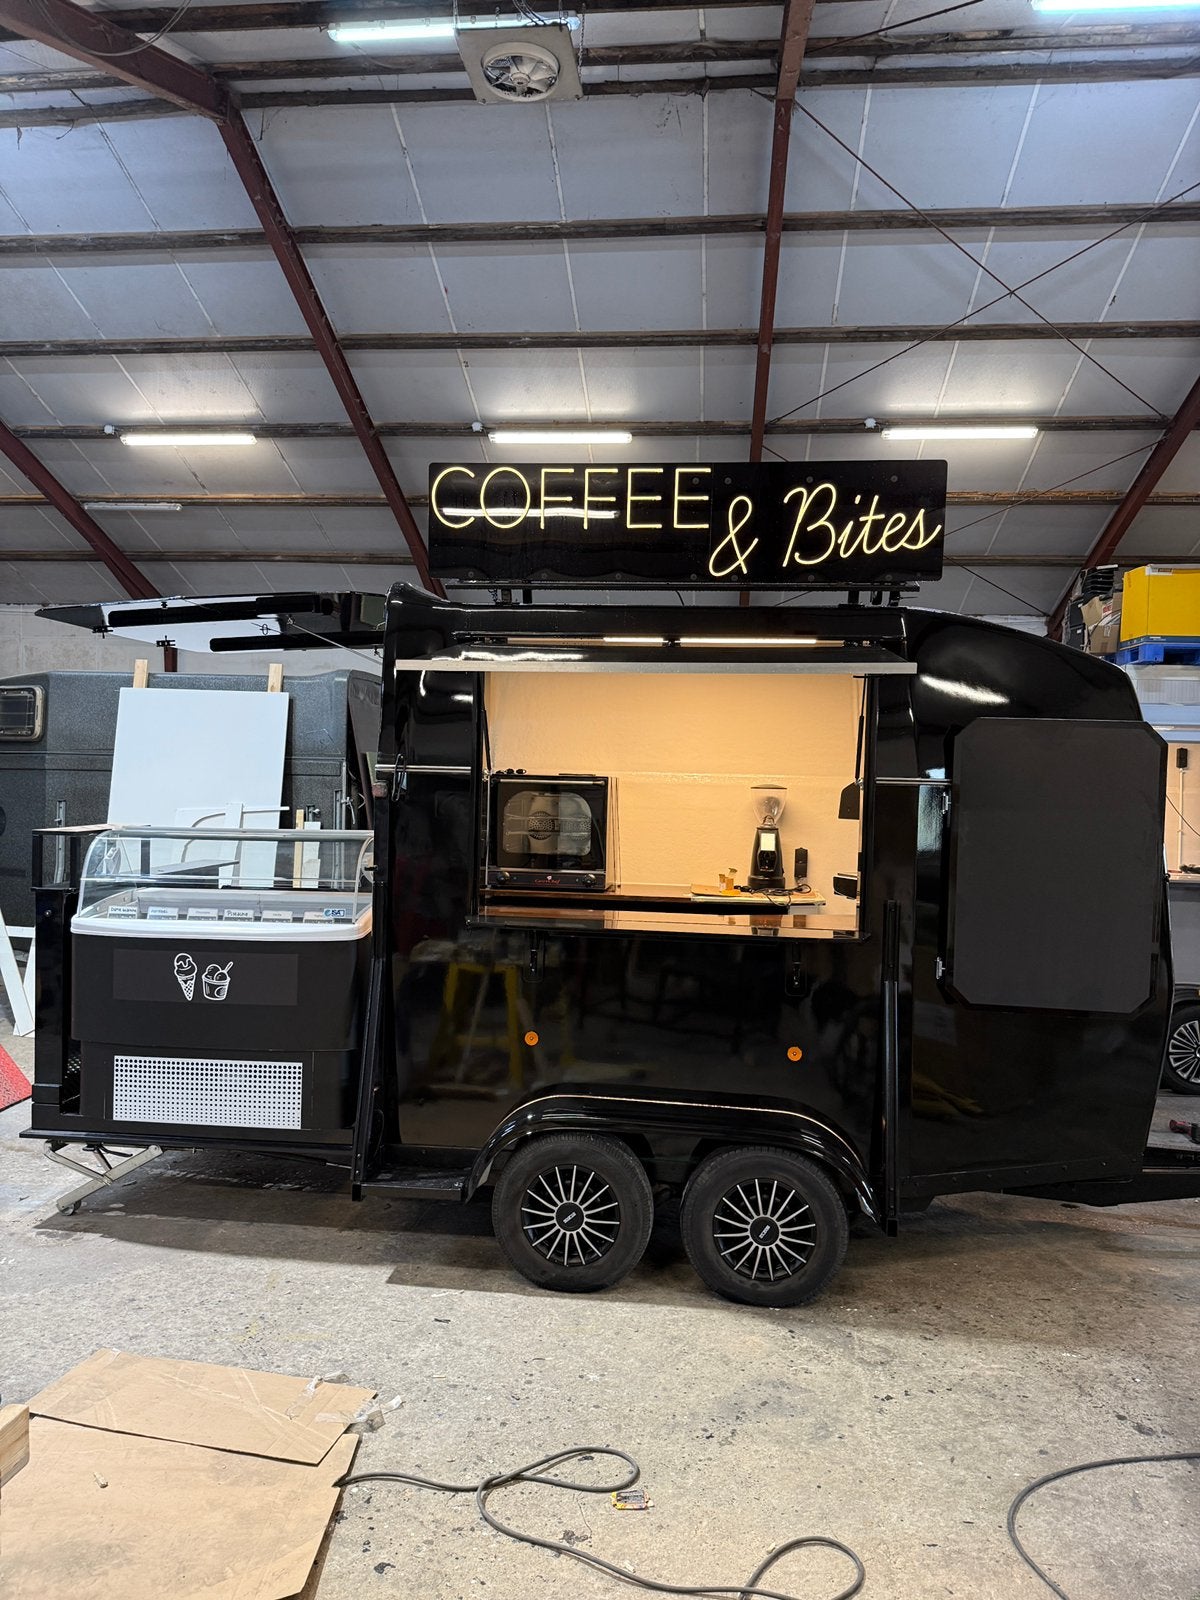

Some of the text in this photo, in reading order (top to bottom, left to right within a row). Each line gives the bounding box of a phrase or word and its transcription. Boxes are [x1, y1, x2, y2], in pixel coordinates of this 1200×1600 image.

[431, 465, 712, 531] COFFEE
[708, 482, 942, 577] & Bites
